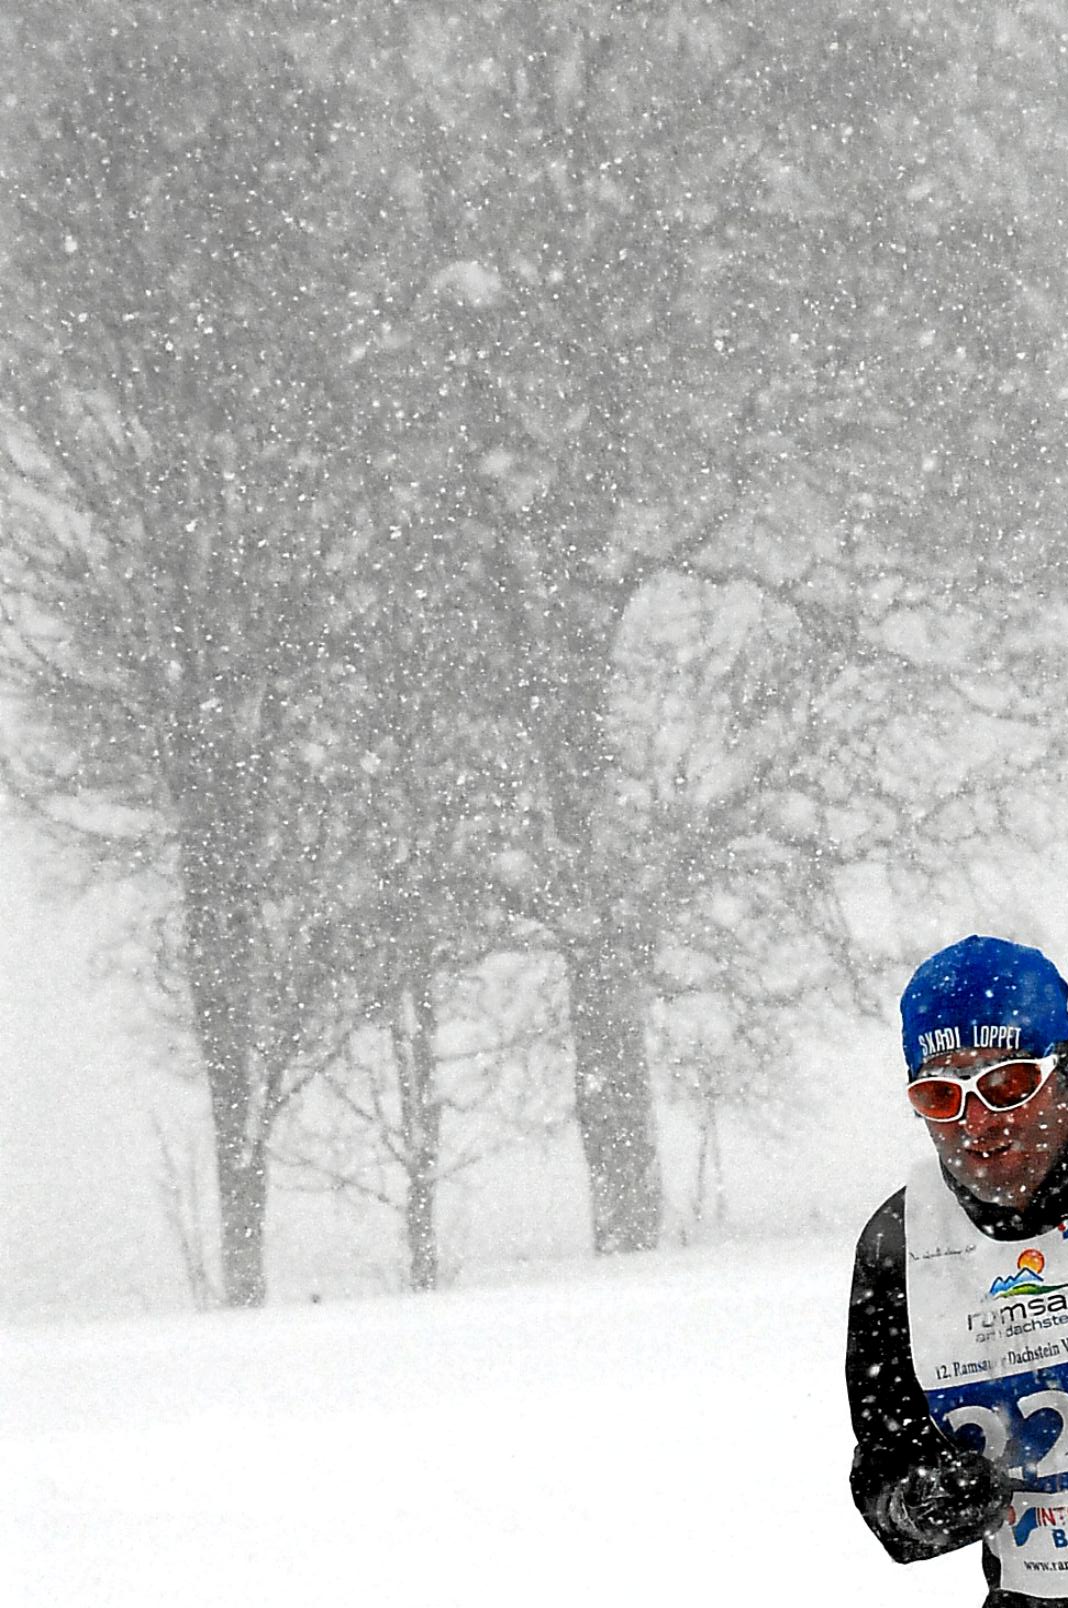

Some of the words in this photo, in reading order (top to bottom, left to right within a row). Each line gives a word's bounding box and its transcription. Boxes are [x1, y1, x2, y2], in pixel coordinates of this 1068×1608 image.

[918, 1026, 962, 1056] SKADI
[973, 1025, 1022, 1050] LOPPET
[1007, 1341, 1060, 1365] Dachstein
